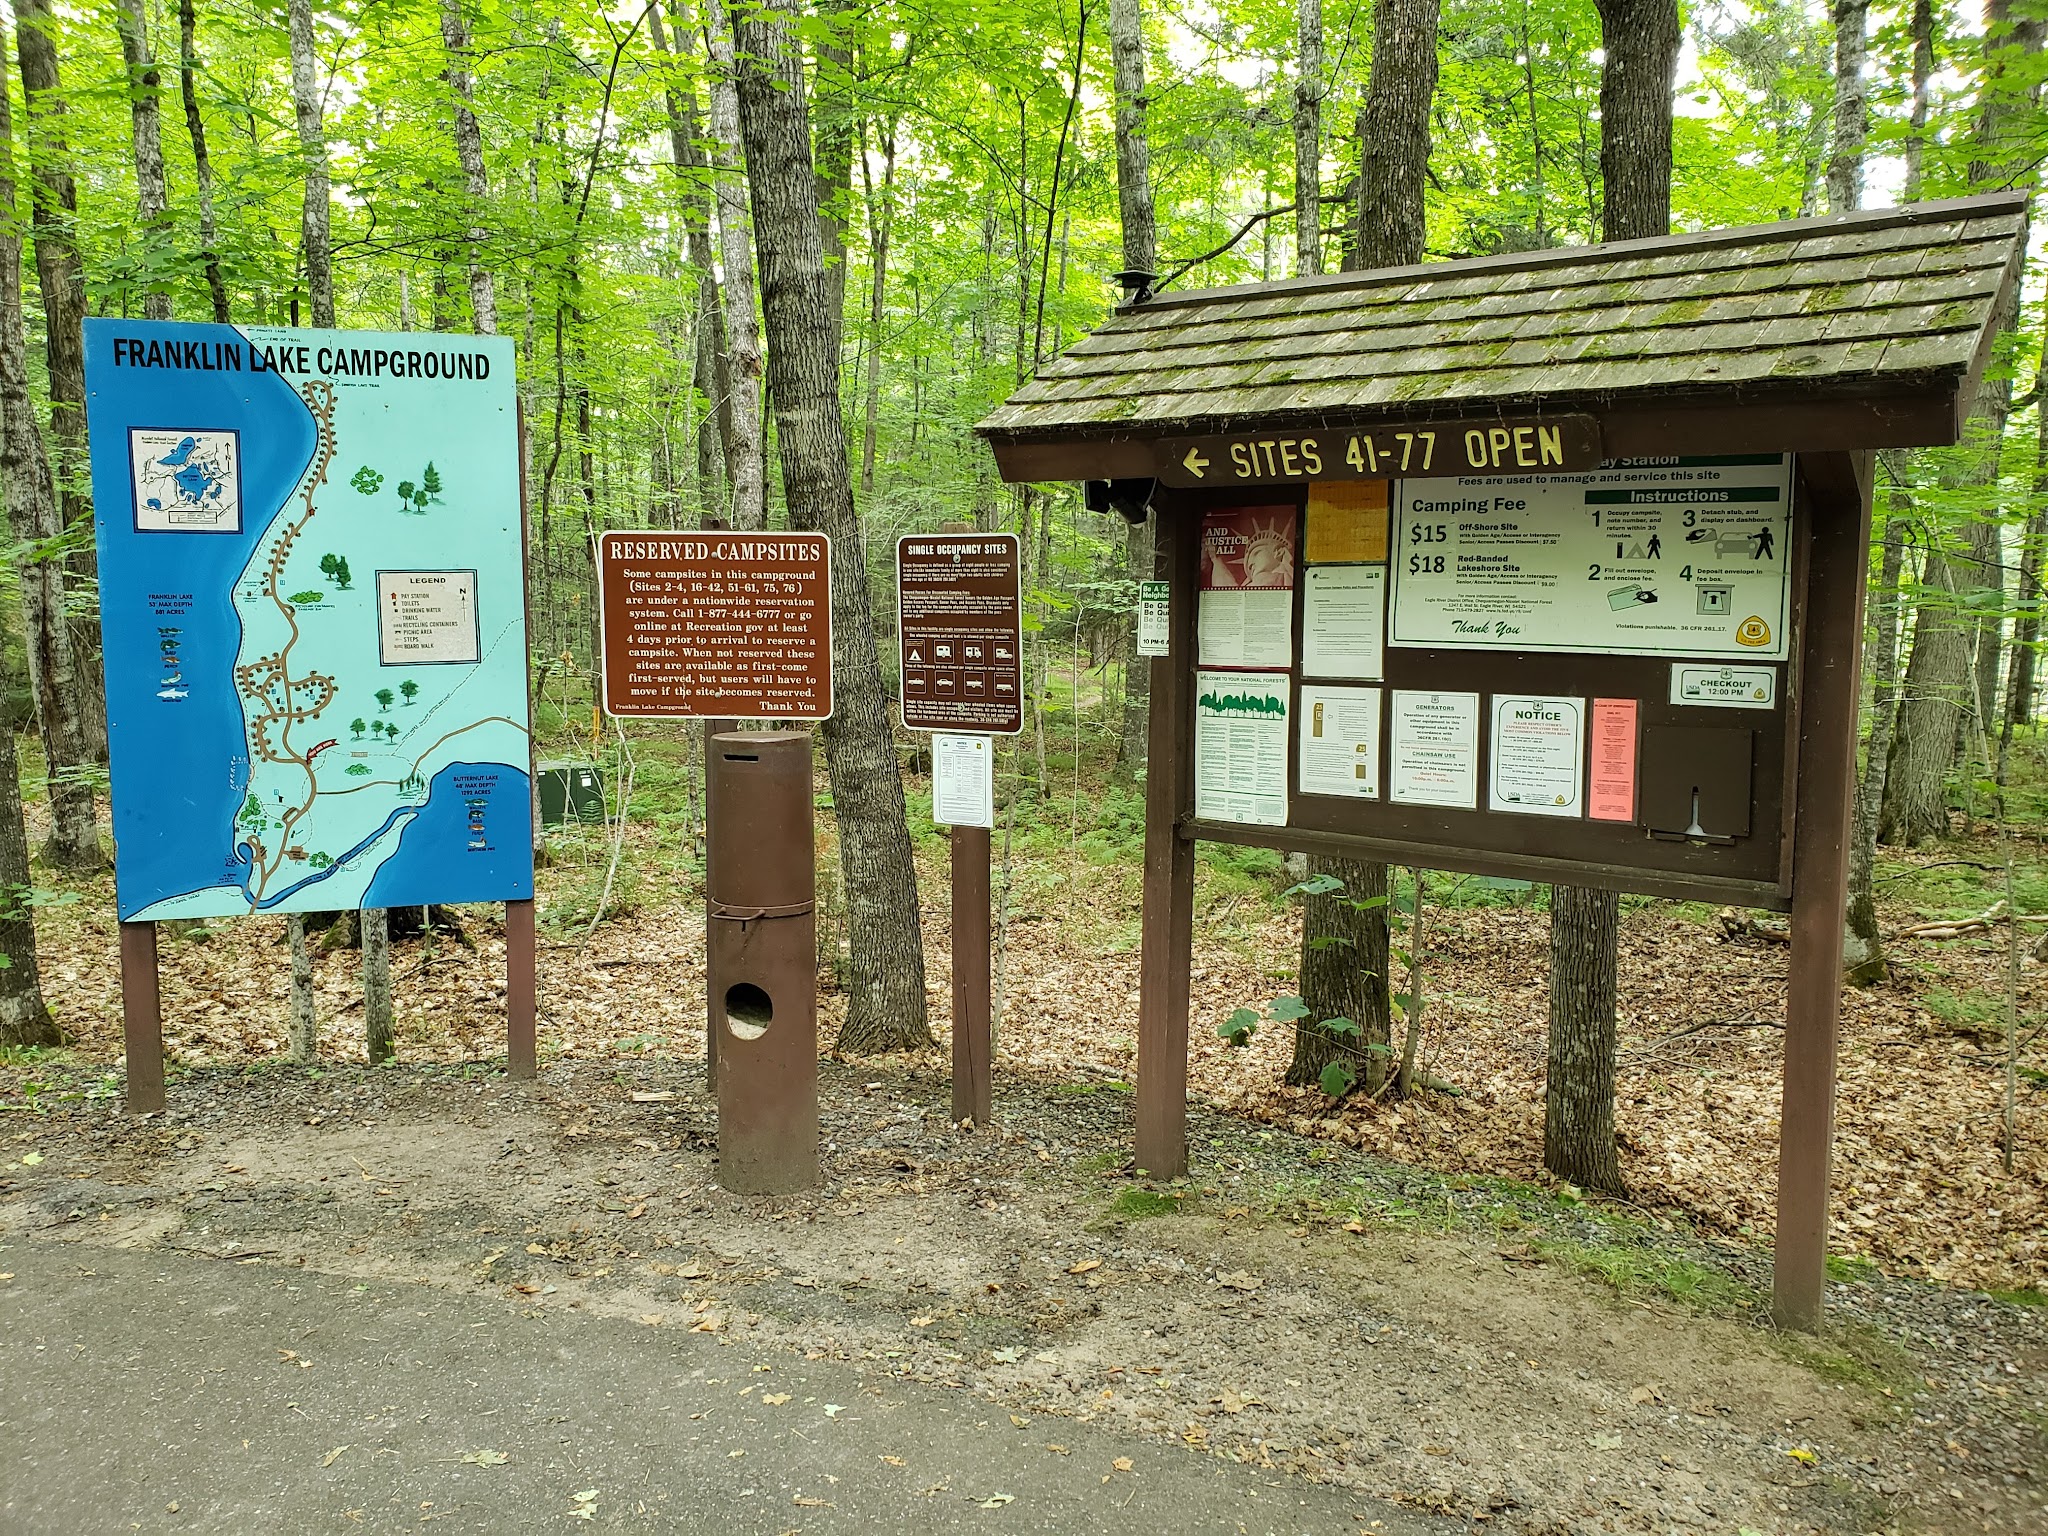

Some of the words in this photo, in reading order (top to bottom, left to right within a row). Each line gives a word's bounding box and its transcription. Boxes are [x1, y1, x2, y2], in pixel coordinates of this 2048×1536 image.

[113, 338, 241, 372] FRANKLIN
[250, 344, 311, 373] LAKE
[318, 348, 489, 380] CAMPGROUND
[1230, 438, 1322, 478] SITES
[1346, 431, 1436, 473] 41-77
[1464, 425, 1563, 468] OPEN
[1622, 456, 1679, 466] Station
[1507, 476, 1532, 484] used
[1551, 475, 1596, 484] manage
[1600, 473, 1620, 482] and
[1625, 471, 1666, 481] service
[1671, 471, 1693, 480] this
[1697, 470, 1720, 479] site
[1630, 490, 1728, 502] Instructions
[1413, 499, 1488, 514] Camping
[1495, 498, 1525, 510] Fee
[1592, 510, 1600, 527] 1
[1682, 510, 1695, 527] 3
[1206, 528, 1228, 536] AND
[1411, 523, 1446, 545] $15
[1205, 536, 1248, 546] JUSTICE
[610, 542, 708, 559] RESERVED
[717, 543, 820, 560] CAMPSITES
[908, 545, 934, 555] SINGLE
[937, 544, 981, 555] OCCUPANCY
[985, 544, 1007, 554] SITES
[1216, 546, 1236, 554] ALL
[1410, 553, 1444, 575] $18
[624, 569, 651, 577] Some
[655, 569, 706, 579] campsites
[712, 570, 722, 578] in
[727, 570, 747, 579] this
[751, 571, 816, 581] campground
[1588, 564, 1600, 581] 2
[1680, 565, 1693, 581] 4
[630, 580, 660, 593] (Sites
[665, 582, 686, 593] 2-4,
[691, 583, 724, 593] 16-42,
[728, 583, 759, 594] 51-61,
[764, 583, 779, 594] 75,
[648, 595, 678, 604] under
[693, 596, 750, 605] nationwide
[756, 598, 814, 606] reservation
[630, 610, 669, 619] system.
[673, 609, 694, 617] Call
[698, 609, 780, 618] 1-877-444-6777
[634, 622, 667, 630] online
[686, 622, 742, 631] Recreation
[783, 623, 808, 632] least
[1452, 620, 1490, 633] Thank
[1495, 621, 1520, 638] You
[627, 635, 633, 643] 4
[638, 634, 660, 645] days
[666, 635, 691, 645] prior
[711, 636, 748, 644] arrival
[629, 648, 678, 658] campsite.
[682, 648, 712, 657] When
[738, 649, 782, 657] reserved
[787, 649, 814, 658] these
[636, 661, 660, 669] sites
[686, 661, 732, 670] available
[753, 662, 808, 671] first-come
[629, 673, 695, 684] first-served,
[699, 674, 716, 683] but
[753, 675, 772, 683] will
[778, 675, 801, 684] have
[662, 687, 670, 695] if
[675, 687, 691, 695] the
[696, 687, 714, 696] site
[719, 687, 762, 696] becomes
[767, 688, 815, 697] reserved.
[759, 701, 793, 710] Thank
[797, 702, 816, 711] You
[1516, 711, 1560, 720] NOTICE
